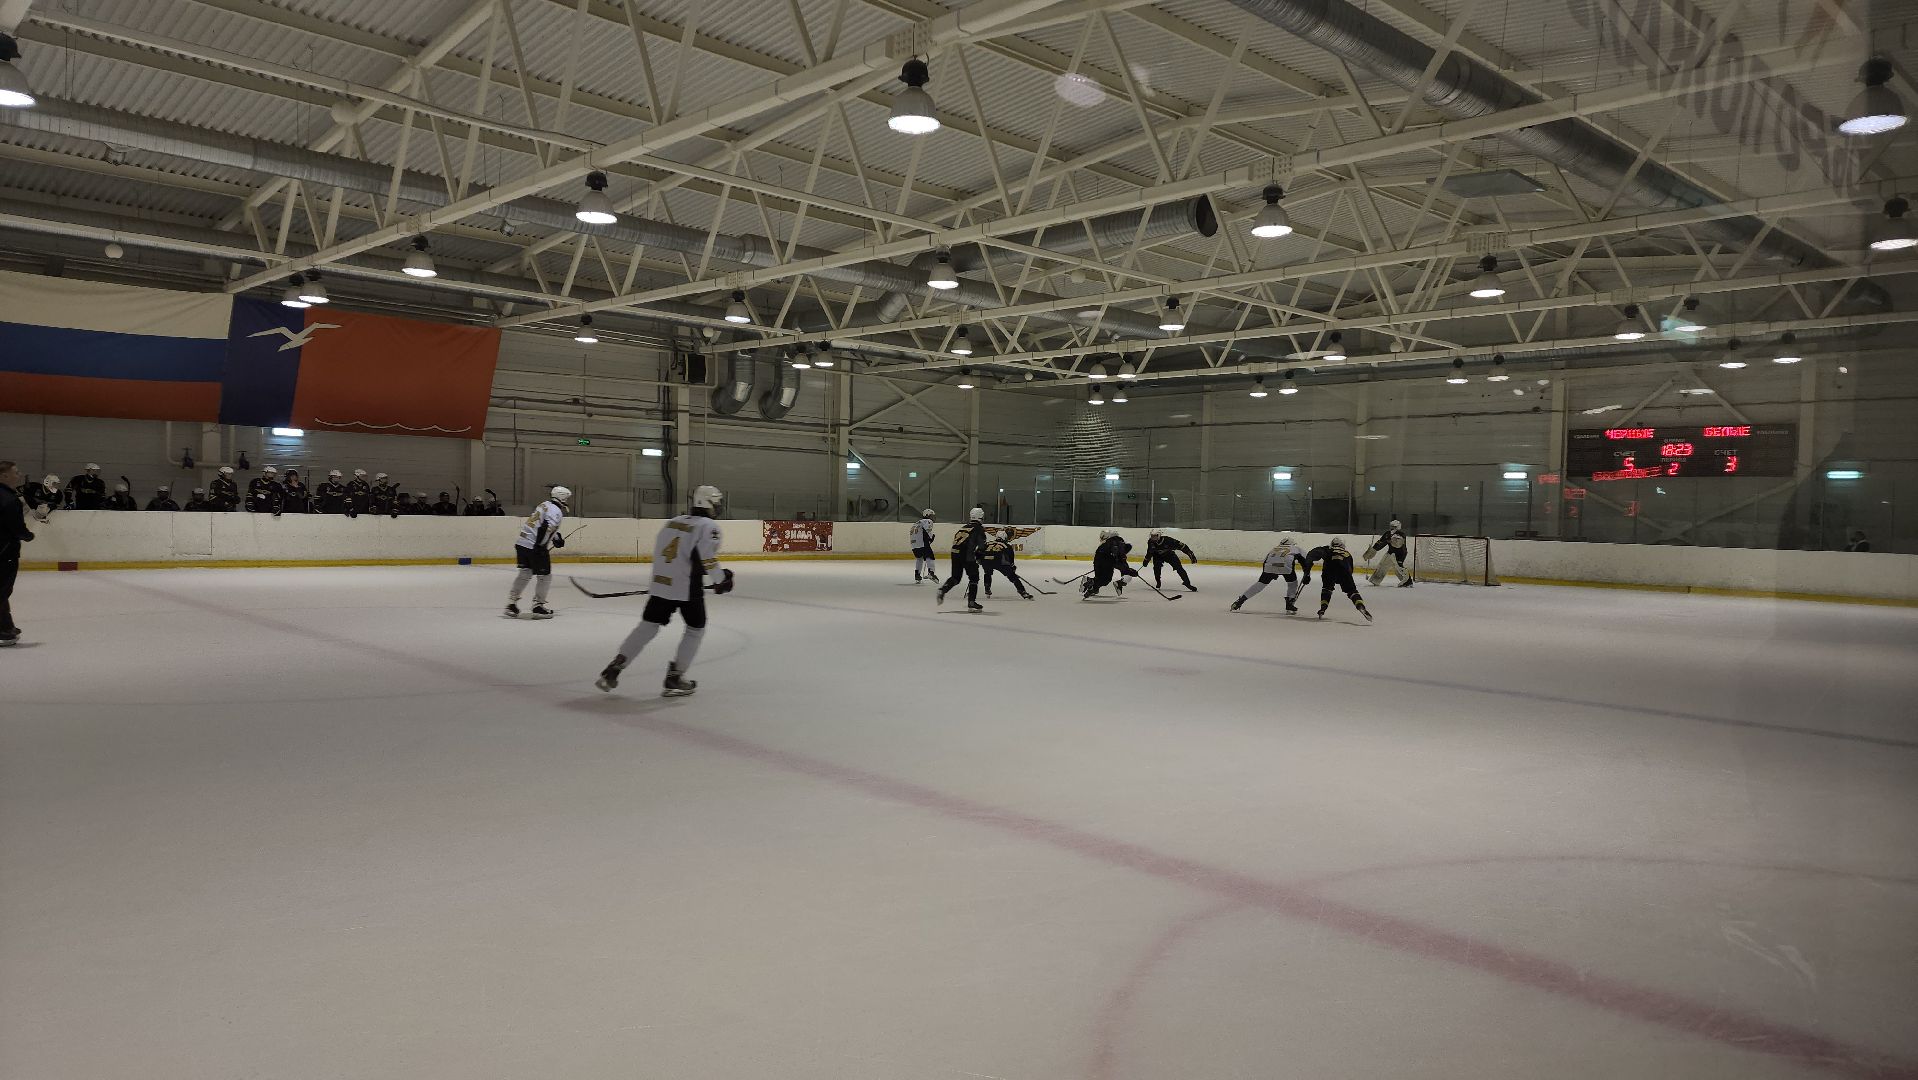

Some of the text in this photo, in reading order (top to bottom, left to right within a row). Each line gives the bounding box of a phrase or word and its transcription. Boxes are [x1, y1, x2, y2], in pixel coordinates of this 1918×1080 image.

[1703, 425, 1752, 437] БЕЛЫЕ
[1661, 443, 1695, 457] 18:23
[1623, 456, 1635, 472] 5
[1667, 462, 1680, 475] 2
[1724, 455, 1739, 472] 3
[784, 529, 813, 540] ЗИМА
[662, 536, 681, 563] 4
